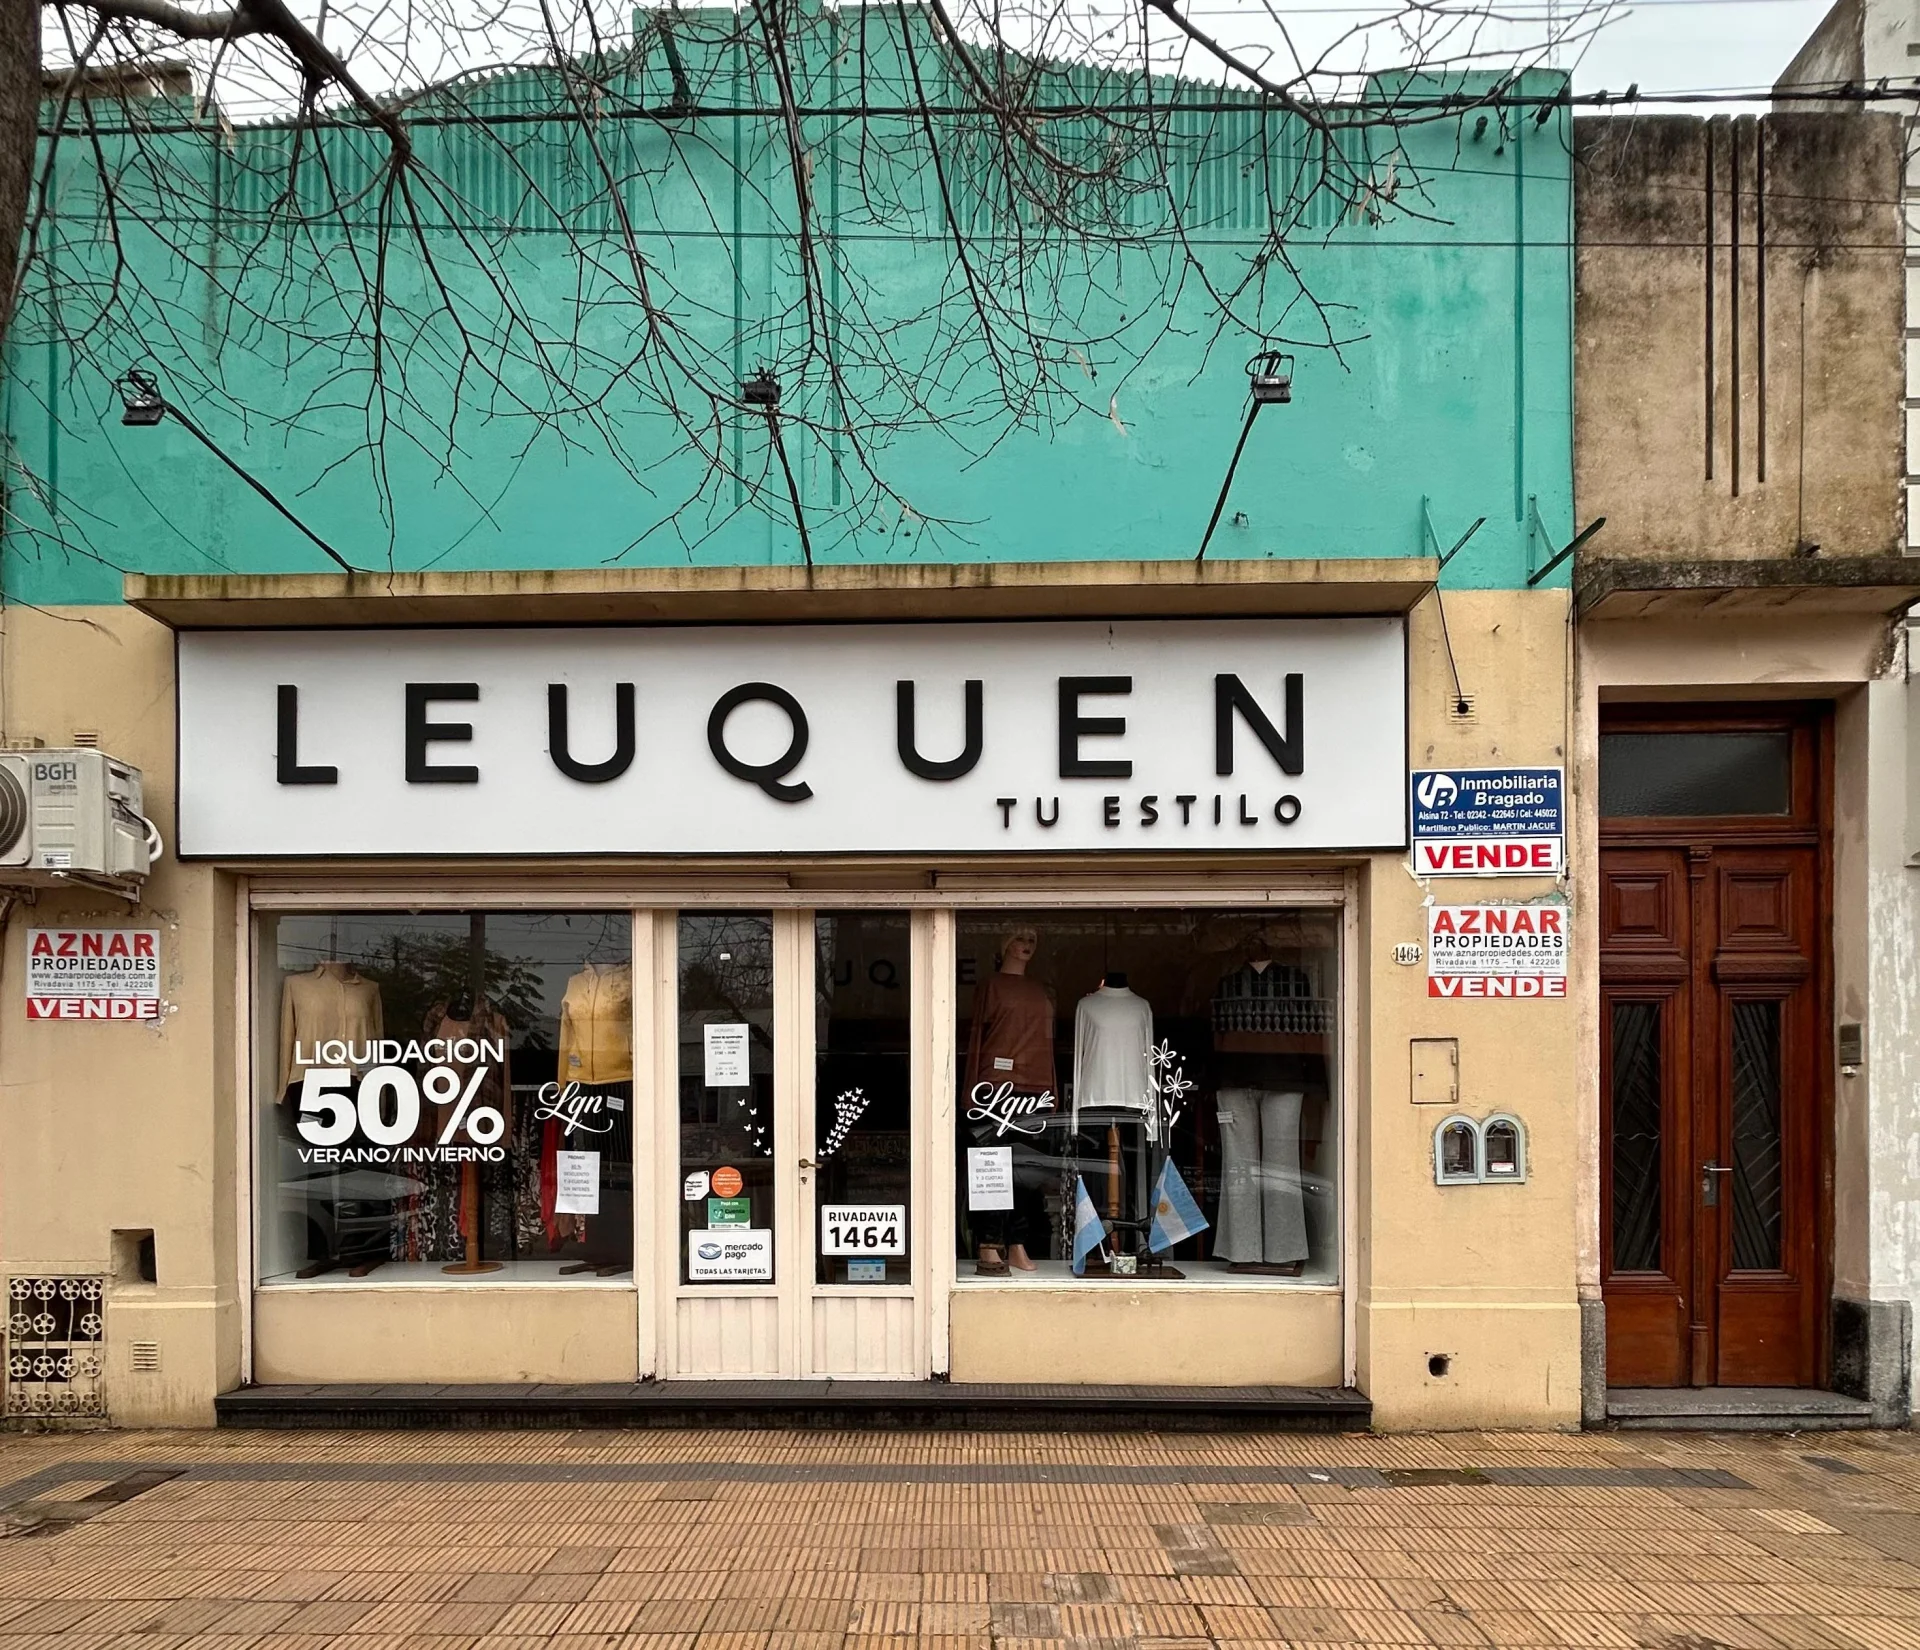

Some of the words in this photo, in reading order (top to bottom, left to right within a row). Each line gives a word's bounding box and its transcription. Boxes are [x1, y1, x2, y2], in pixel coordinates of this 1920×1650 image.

[277, 673, 1304, 802] LEUQUEN
[35, 763, 77, 780] BGH
[1461, 775, 1557, 790] Inmobiliaria
[1475, 791, 1544, 807] Bragado
[996, 796, 1060, 828] TU
[1103, 794, 1301, 826] ESTILO
[1418, 811, 1440, 820] Alsina
[1440, 811, 1448, 820] 72
[1453, 810, 1466, 820] Tel:
[1466, 810, 1487, 819] 02342
[1491, 810, 1515, 818] 422645
[1520, 809, 1534, 818] Cel:
[1534, 808, 1558, 818] 445022
[1492, 822, 1526, 831] MARTIN
[1527, 822, 1556, 830] JACUE
[1424, 844, 1553, 869] VENDE
[1433, 910, 1562, 934] AZNAR
[31, 932, 155, 957] AZNAR
[1433, 936, 1563, 948] PROPIEDADES
[1394, 946, 1420, 962] 1464
[1433, 949, 1564, 957] www.aznarpropiedades.com.ar
[32, 958, 156, 970] PROPIEDADES
[1433, 977, 1565, 997] VENDE
[31, 999, 158, 1018] VENDE
[295, 1038, 504, 1065] LIQUIDACION
[296, 1065, 505, 1146] 50%
[297, 1146, 505, 1163] VERANO/INVIERNO
[828, 1212, 898, 1222] RIVADAVIA
[829, 1226, 898, 1248] 1464
[724, 1242, 764, 1250] mercado
[724, 1251, 746, 1260] pago
